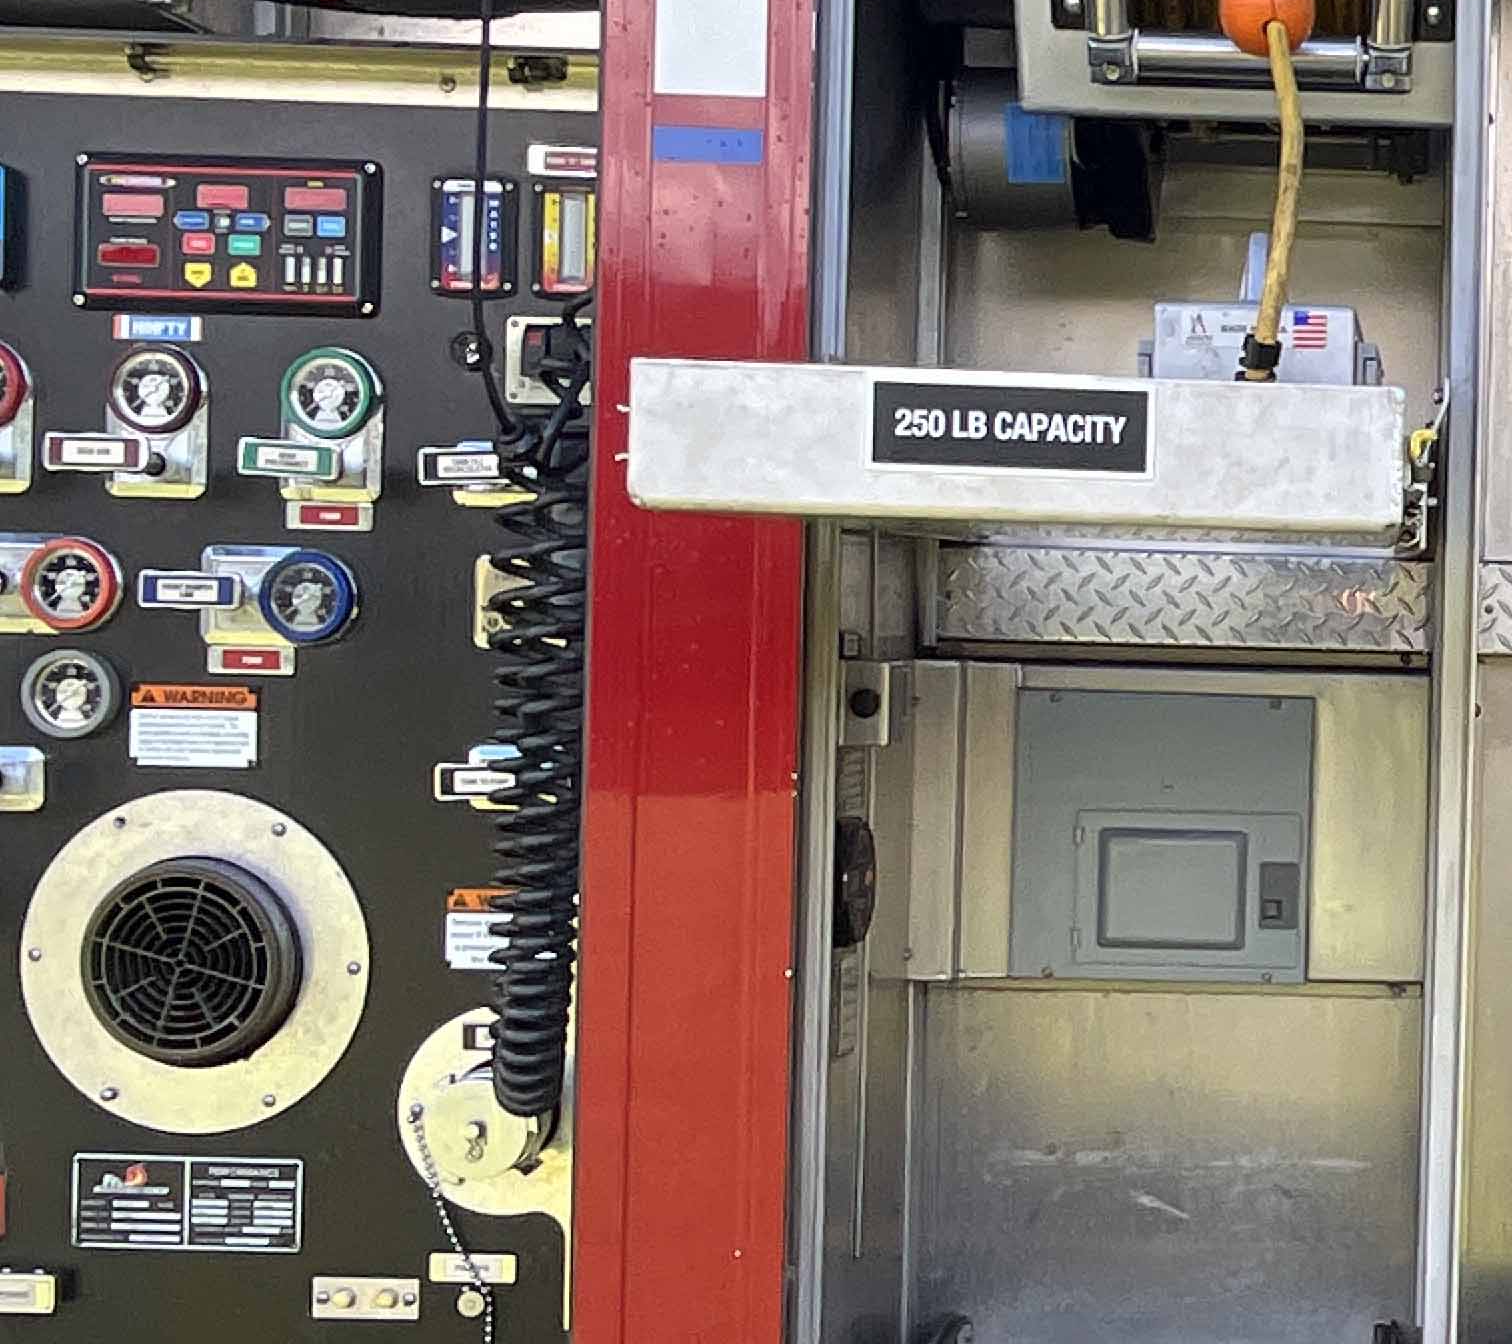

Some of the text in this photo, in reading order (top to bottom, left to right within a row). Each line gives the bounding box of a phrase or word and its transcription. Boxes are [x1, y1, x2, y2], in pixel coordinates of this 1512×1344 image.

[894, 407, 1128, 445] 250 LB CAPACITY
[164, 689, 248, 705] WARNING
